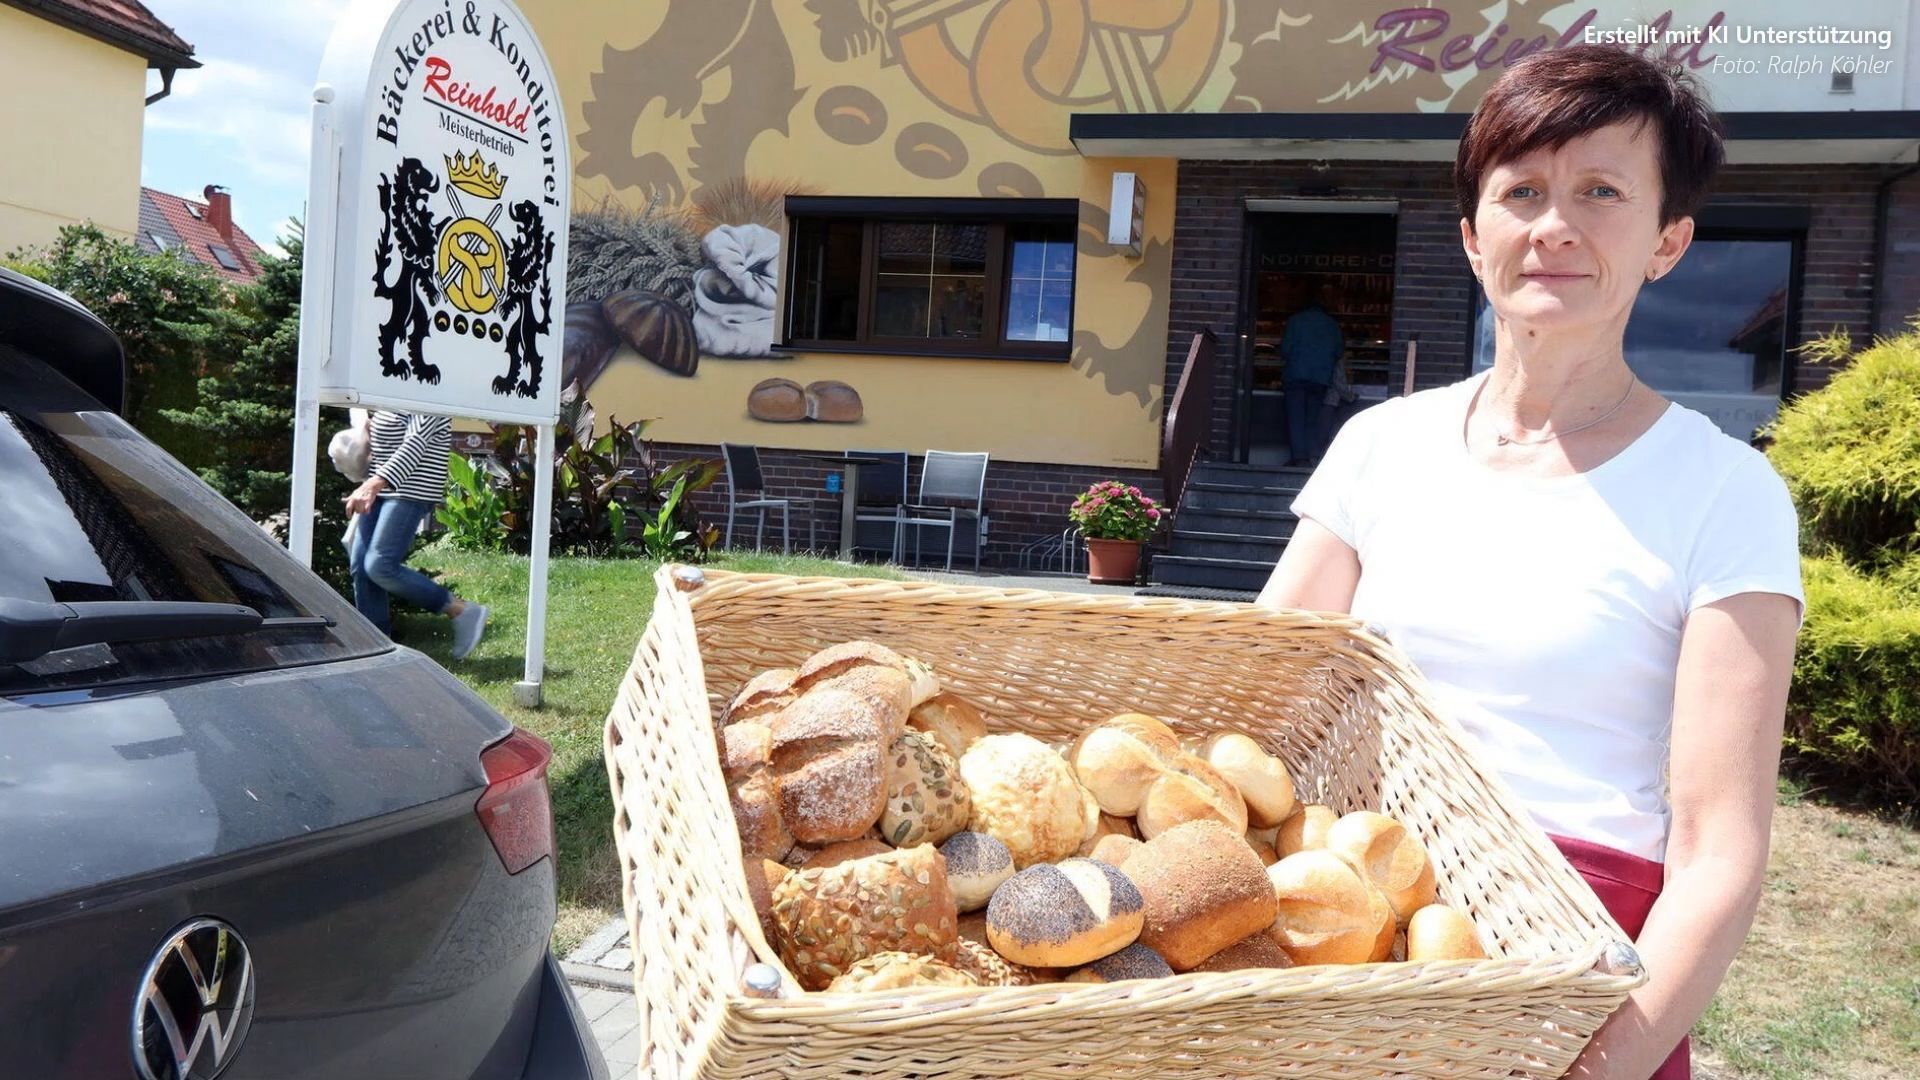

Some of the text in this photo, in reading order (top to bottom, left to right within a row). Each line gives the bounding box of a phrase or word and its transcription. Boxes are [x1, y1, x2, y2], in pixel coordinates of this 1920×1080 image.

[376, 0, 560, 208] Bäckerei & Konditorei
[423, 56, 531, 134] Reinhold
[438, 111, 516, 158] Meisterbetrieb
